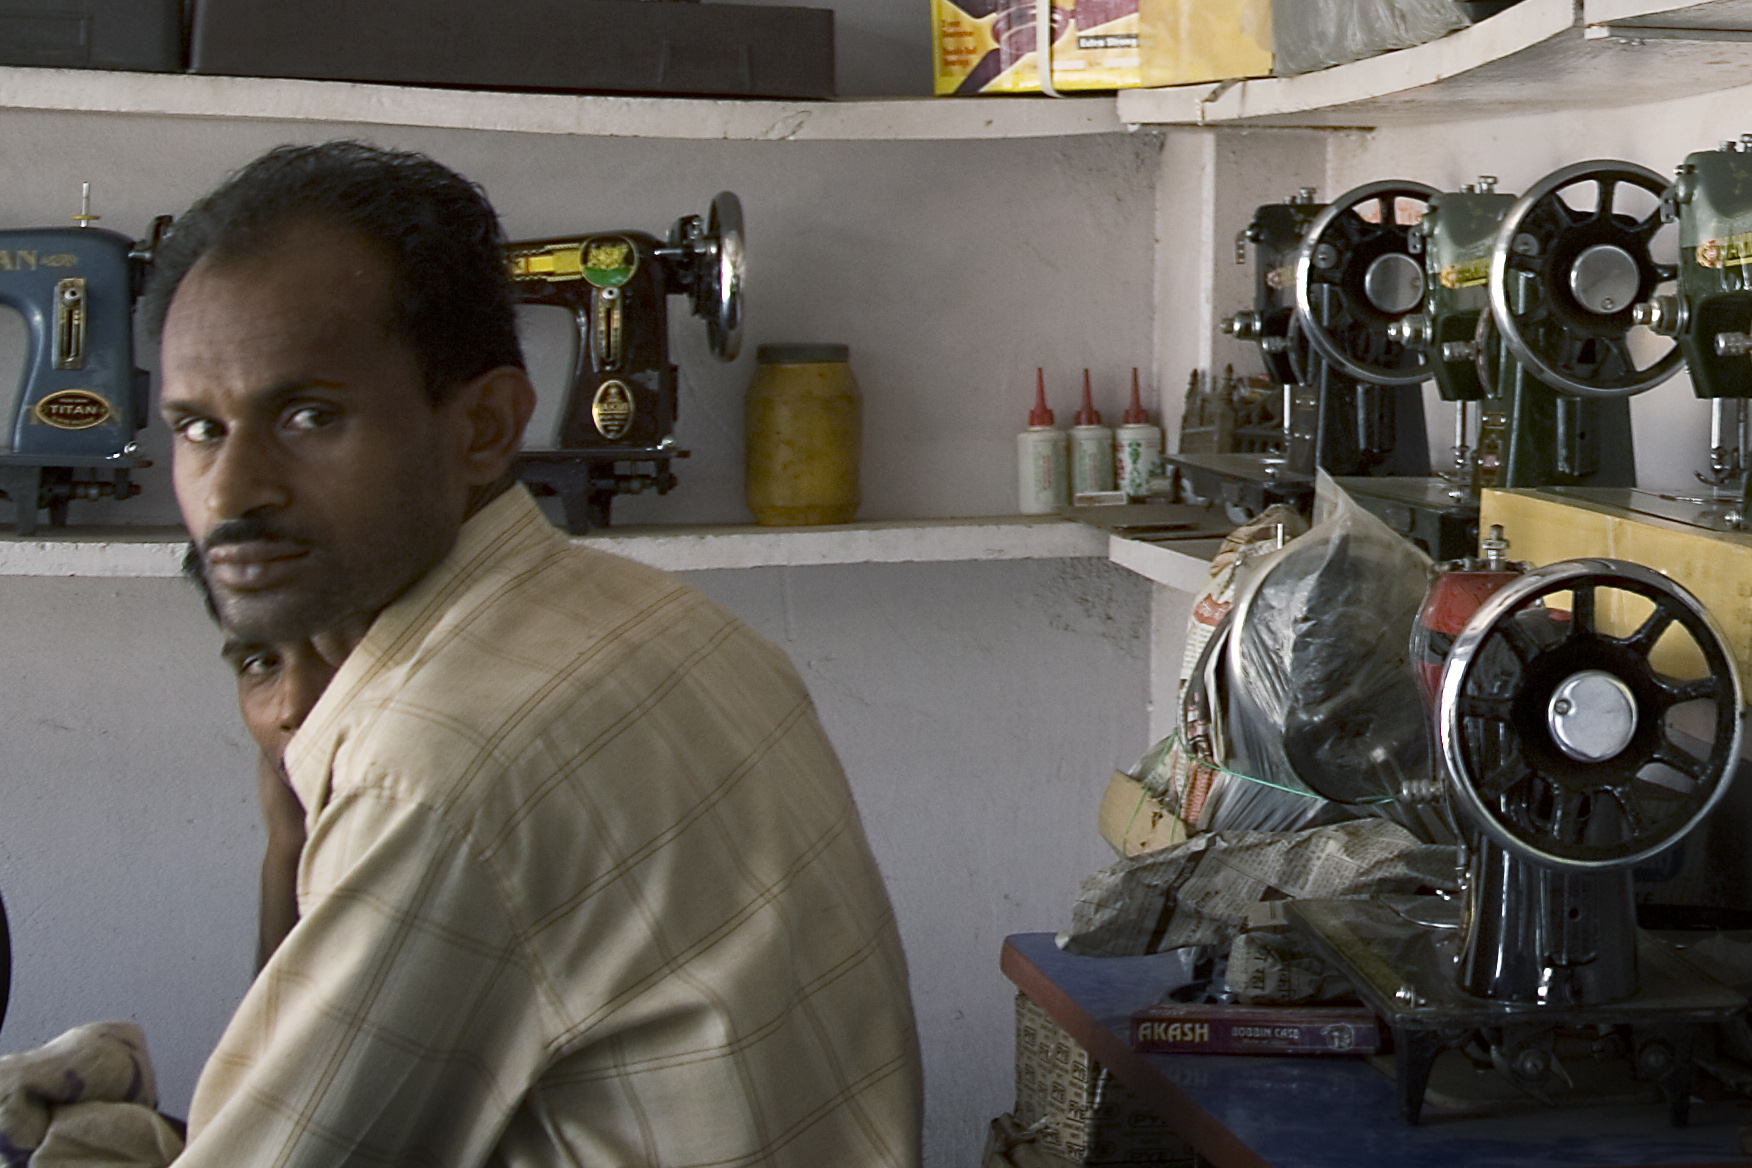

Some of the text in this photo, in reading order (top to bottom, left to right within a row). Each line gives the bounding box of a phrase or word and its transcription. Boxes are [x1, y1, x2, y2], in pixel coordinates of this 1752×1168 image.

[50, 404, 98, 415] TITAN
[1138, 1022, 1209, 1043] AKASH
[1231, 1026, 1299, 1039] BOBBIN CASE
